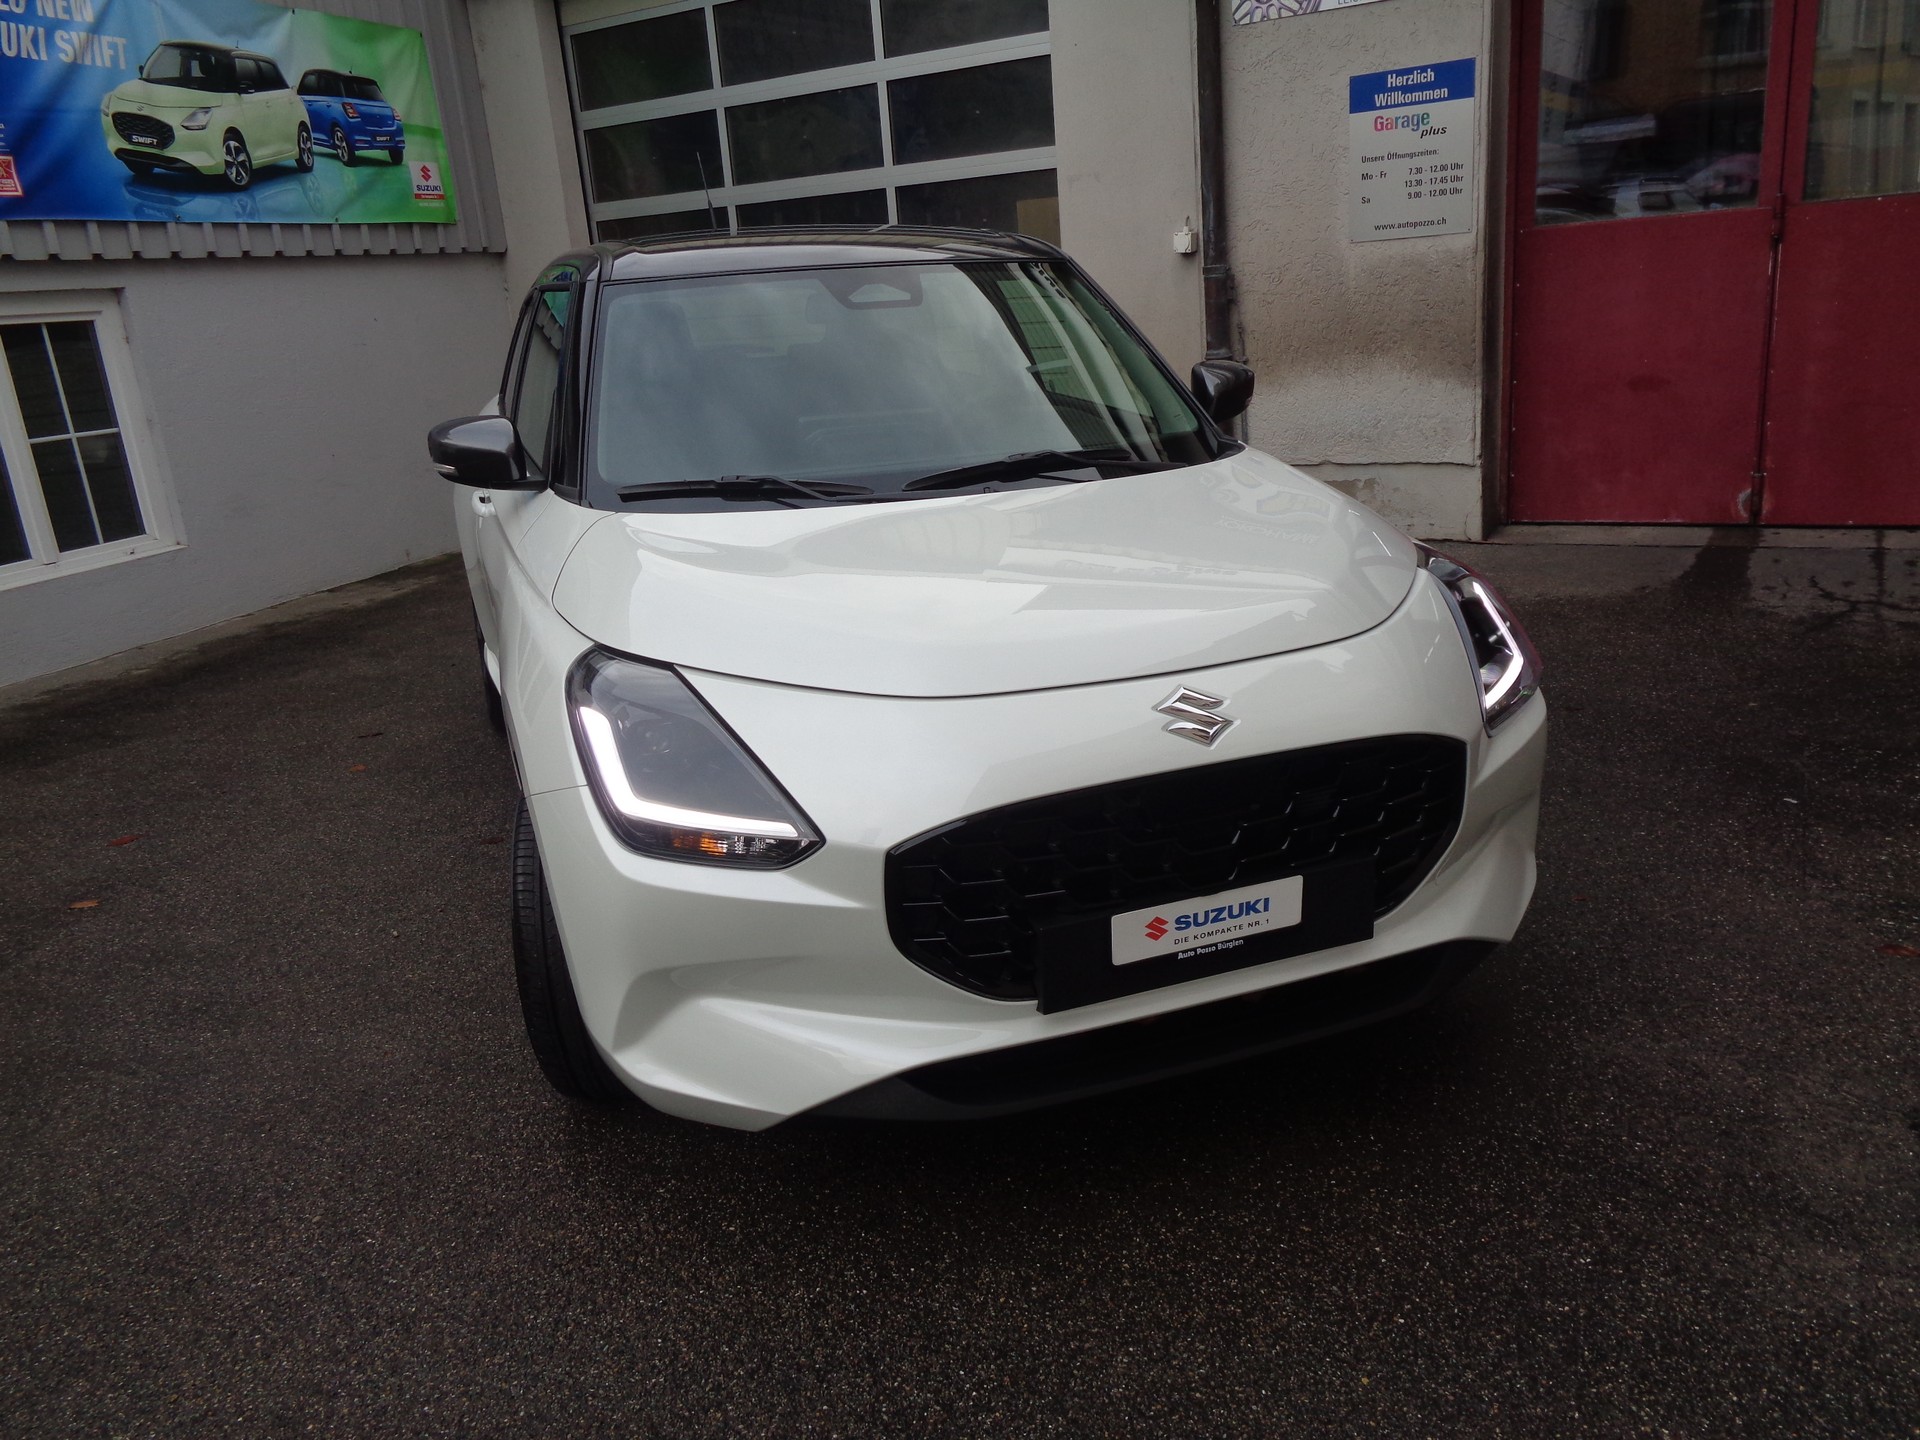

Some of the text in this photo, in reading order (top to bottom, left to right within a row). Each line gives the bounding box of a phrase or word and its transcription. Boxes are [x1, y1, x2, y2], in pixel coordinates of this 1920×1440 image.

[54, 29, 128, 69] SWIFT
[1387, 68, 1435, 88] Herzlich
[1374, 87, 1448, 107] Willkommen
[1374, 112, 1430, 132] Garage
[132, 135, 157, 145] SWIFT
[1420, 126, 1447, 139] plus
[1361, 148, 1440, 163] Unsere Öffnungszeiten:
[1361, 173, 1373, 181] Mo
[1380, 171, 1387, 179] Fr
[1408, 167, 1423, 176] 7.30
[1430, 164, 1449, 174] 12.00
[1450, 162, 1464, 171] Uhr
[416, 184, 442, 192] SUZUKI
[1405, 179, 1423, 188] 13.30
[1430, 176, 1449, 185] 17.45
[1450, 174, 1464, 183] Uhr
[1361, 196, 1371, 204] Sa
[1407, 191, 1422, 200] 9.00
[1429, 188, 1448, 198] 12.00
[1449, 186, 1463, 195] Uhr
[1374, 217, 1447, 231] www.autopozzo.ch
[1174, 897, 1270, 931] SUZUKI
[1174, 936, 1189, 945] DIE
[1193, 924, 1244, 940] KOMPAKTE
[1247, 920, 1263, 929] NR.
[1177, 950, 1195, 960] Auto
